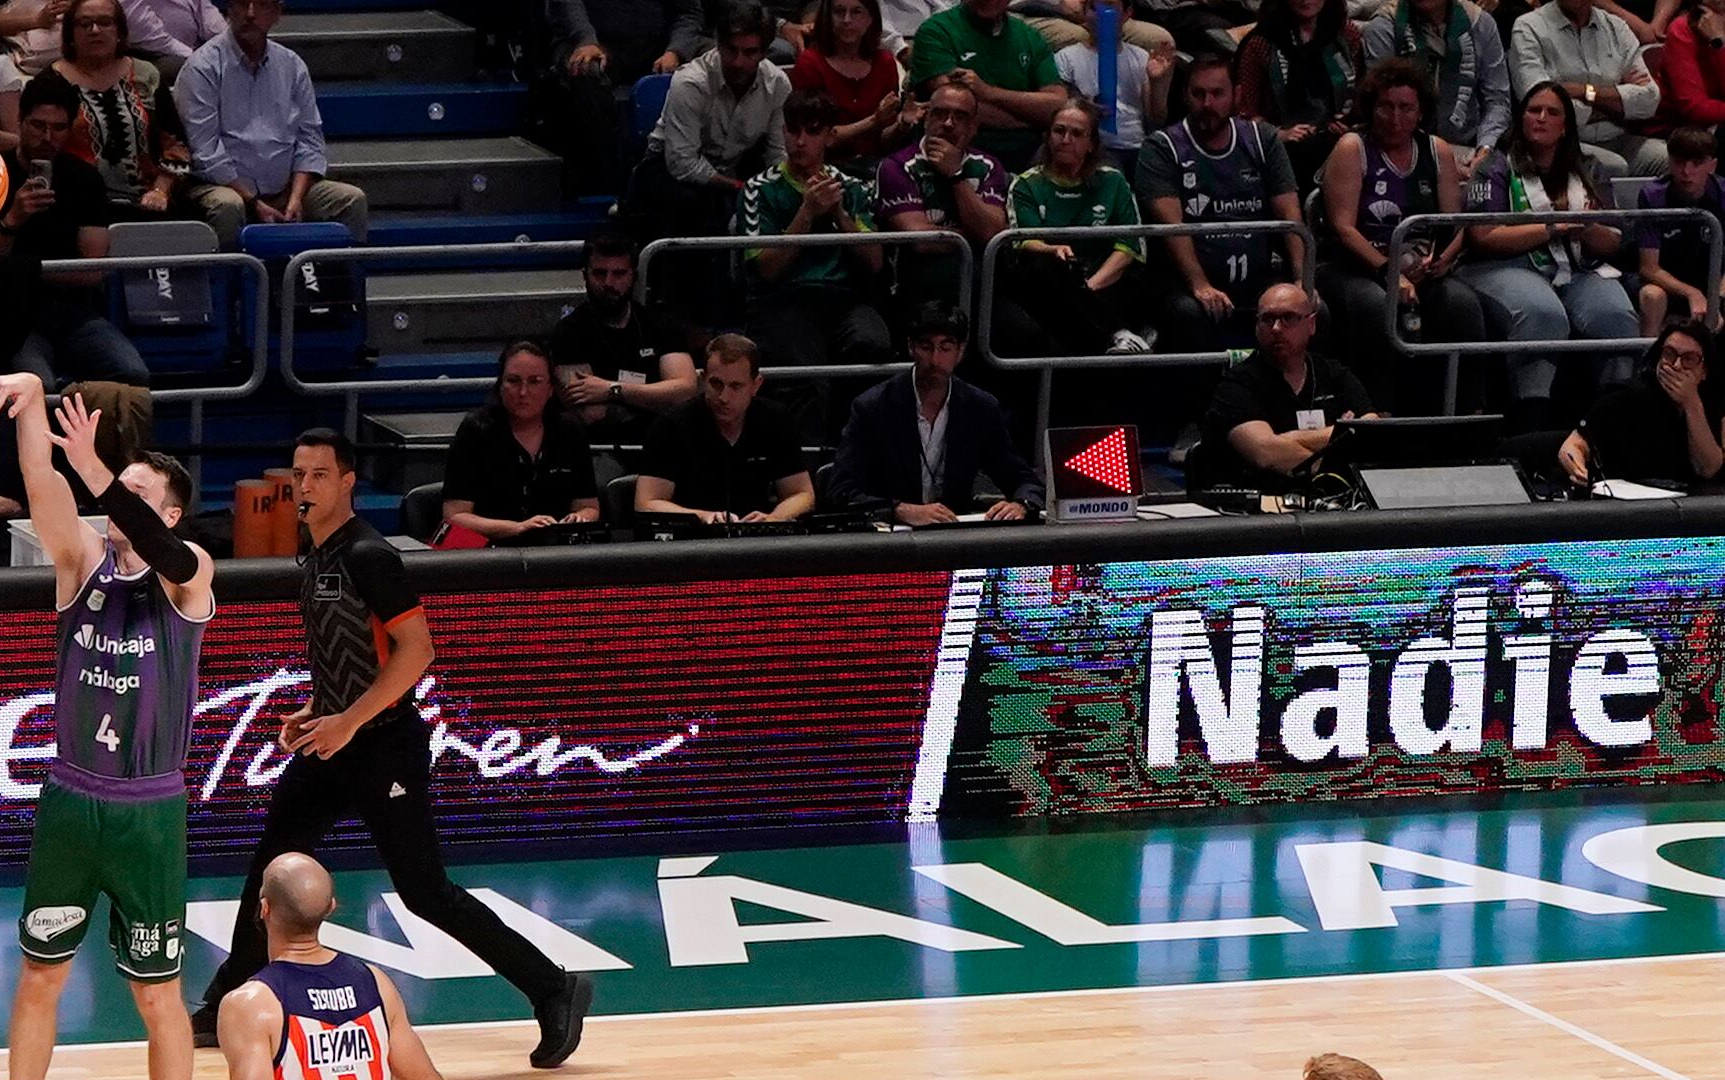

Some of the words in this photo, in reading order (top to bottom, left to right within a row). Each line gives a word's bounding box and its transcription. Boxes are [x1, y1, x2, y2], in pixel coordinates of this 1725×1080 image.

[1226, 253, 1248, 283] 11
[1079, 501, 1129, 514] MONDO
[1146, 580, 1663, 768] Nadie
[95, 713, 121, 752] 4
[307, 986, 357, 1011] SCRUBB
[309, 1028, 372, 1065] LEYMA
